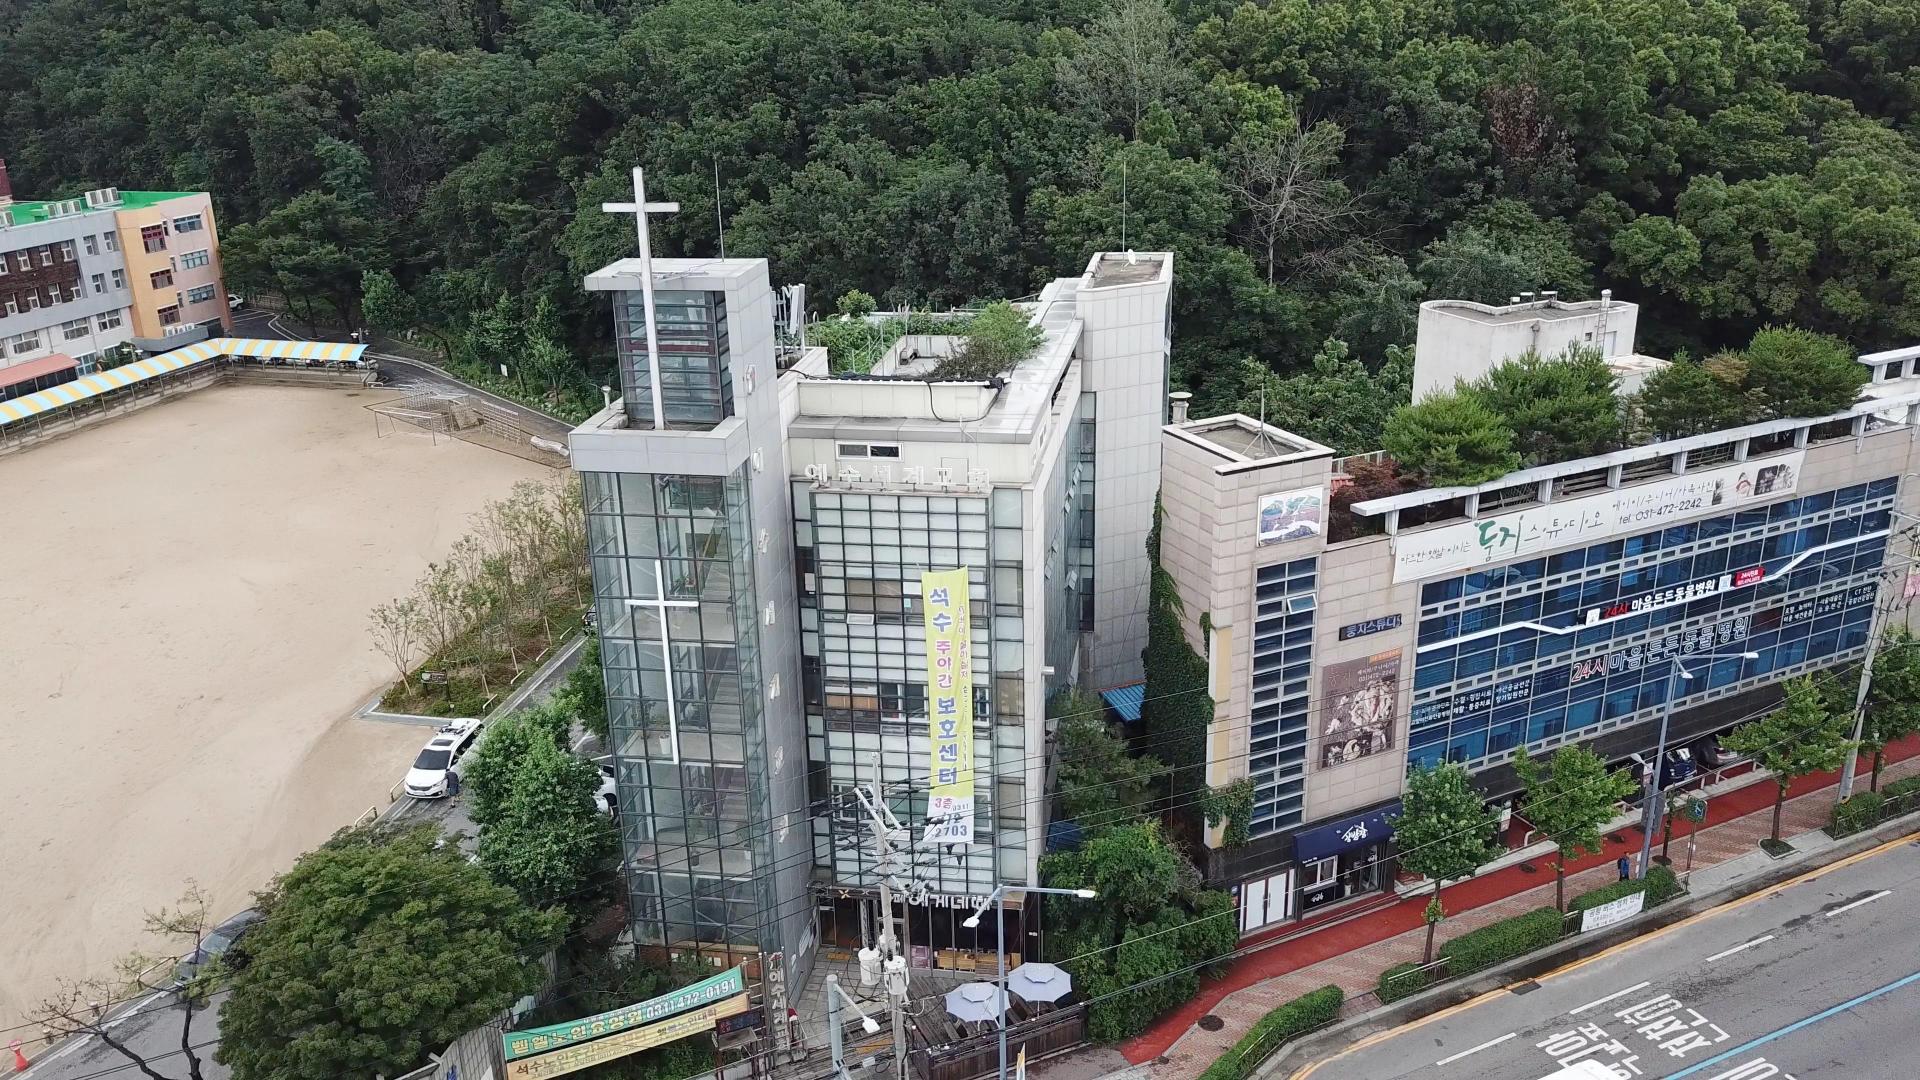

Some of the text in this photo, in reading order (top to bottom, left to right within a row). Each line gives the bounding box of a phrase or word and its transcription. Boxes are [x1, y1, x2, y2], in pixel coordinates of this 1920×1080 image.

[1635, 498, 1702, 522] 031-472-2242
[1631, 579, 1716, 612] 마음든든동물병원
[929, 586, 958, 785] 석수 주야간 보호센터
[934, 798, 953, 810] 3층
[1614, 993, 1730, 1058] 천천히
